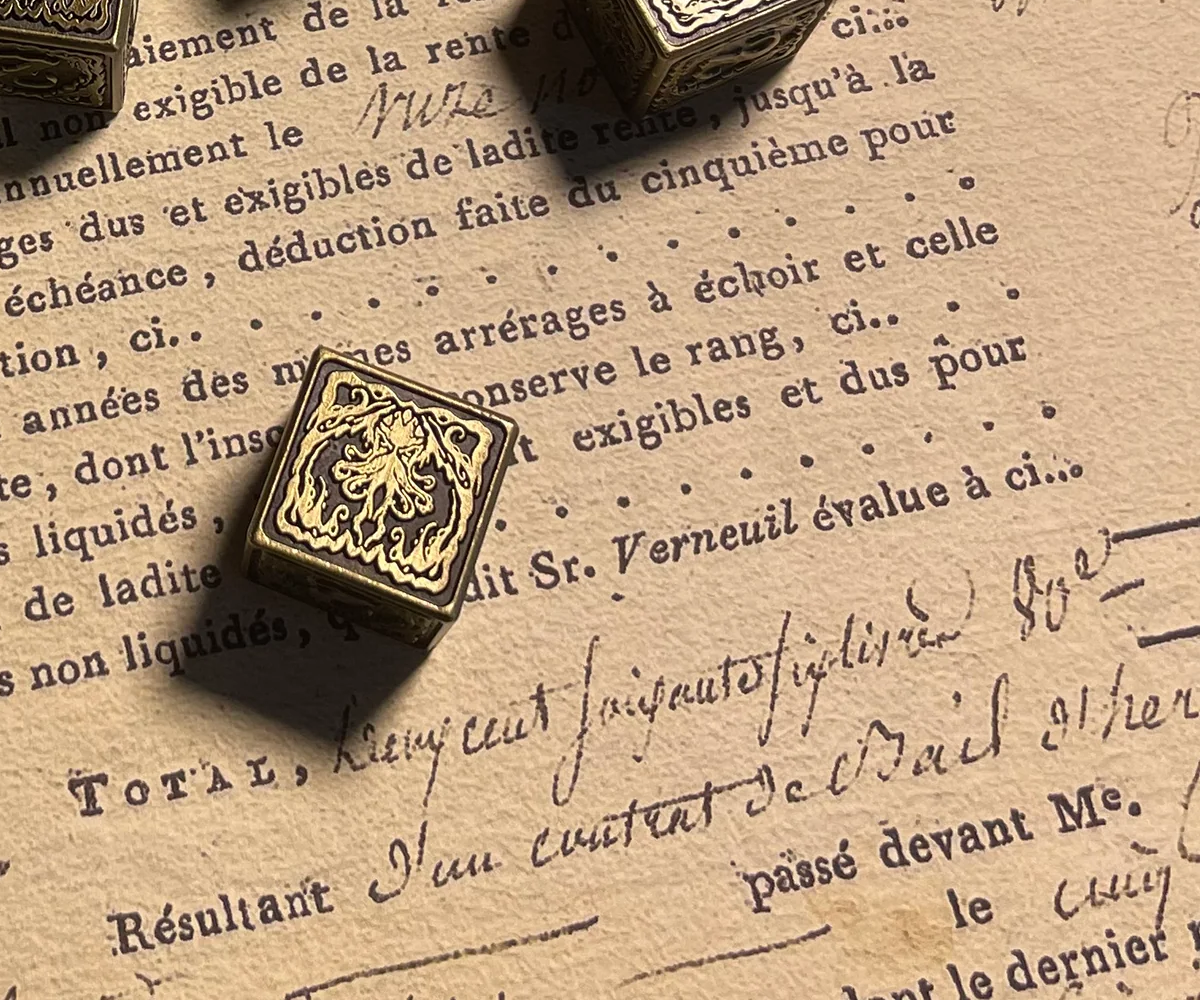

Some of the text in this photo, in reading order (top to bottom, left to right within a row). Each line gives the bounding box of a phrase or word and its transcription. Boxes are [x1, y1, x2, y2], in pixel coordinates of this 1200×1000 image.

[39, 21, 531, 142] non exigible de la rente
[78, 211, 146, 243] dus
[169, 199, 210, 228] et
[224, 162, 392, 218] exigibles
[405, 149, 454, 181] de
[468, 124, 579, 170] ladite
[889, 52, 938, 86] la
[264, 119, 305, 150] le
[237, 214, 438, 273] déduction
[455, 196, 551, 232] faite
[568, 175, 622, 212] du
[641, 139, 850, 197] cinquième
[859, 106, 958, 161] pour
[22, 384, 162, 436] années
[182, 366, 250, 403] des
[434, 297, 628, 358] arrérages
[844, 241, 886, 273] et
[905, 218, 1000, 261] celle
[73, 445, 170, 488] dont
[638, 346, 673, 379] le
[573, 389, 751, 454] exigibles
[780, 375, 823, 411] et
[839, 352, 911, 396] dus
[23, 585, 76, 623] de
[100, 559, 223, 610] ladite
[611, 496, 800, 575] Verneuil
[812, 477, 951, 532] évalue
[30, 644, 110, 692] non
[746, 841, 859, 912] passé
[879, 807, 1034, 869] devant
[946, 888, 993, 929] le
[112, 880, 334, 956] Résultant
[1006, 929, 1169, 992] dernier
